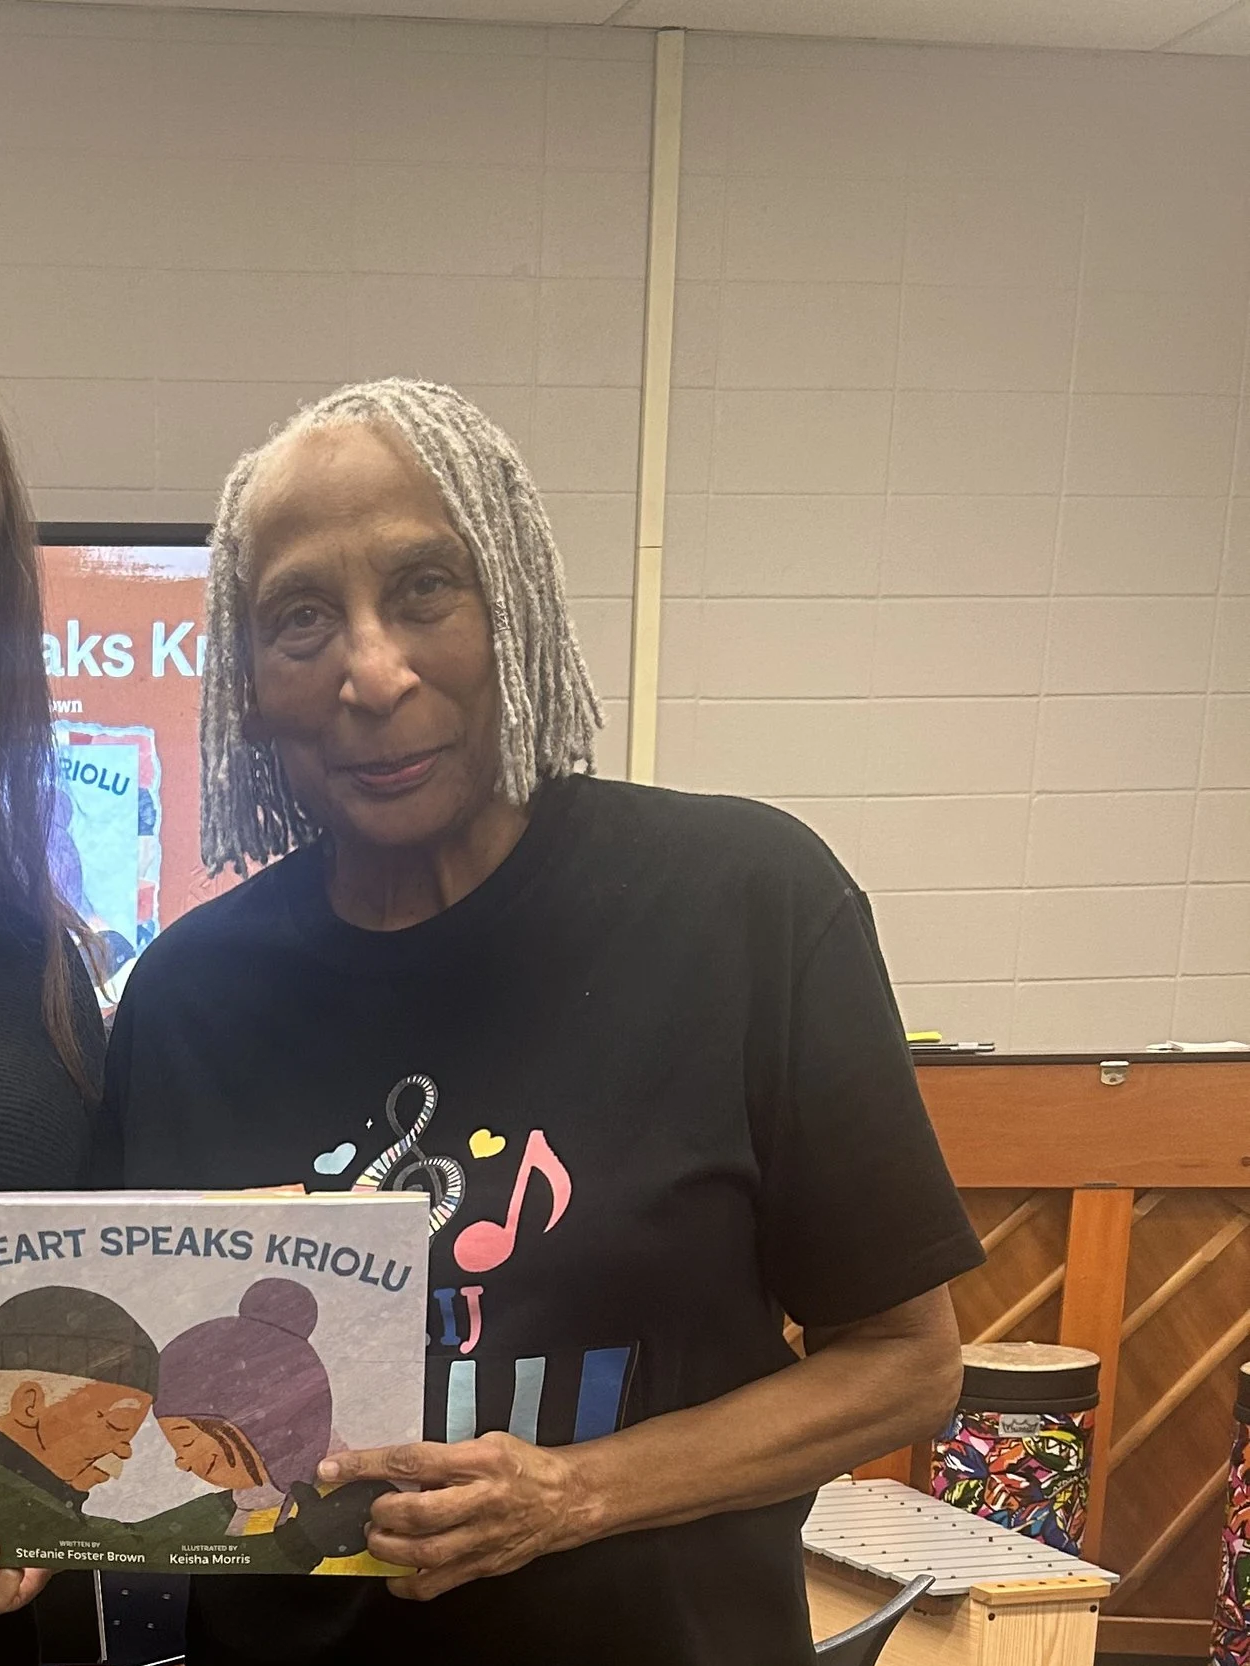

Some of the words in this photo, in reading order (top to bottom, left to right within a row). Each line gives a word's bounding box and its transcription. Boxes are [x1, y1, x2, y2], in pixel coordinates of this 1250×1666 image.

[43, 619, 135, 678] aks
[49, 700, 83, 713] own
[59, 757, 130, 796] RIOLU
[100, 1226, 254, 1261] SPEAKS
[265, 1234, 413, 1292] KRIOLU
[59, 1540, 91, 1548] WRITTEN
[15, 1547, 65, 1560] Stefanie
[67, 1549, 105, 1561] Foster
[107, 1551, 146, 1563] Brown
[169, 1553, 209, 1565] Keisha
[212, 1553, 251, 1565] Morris
